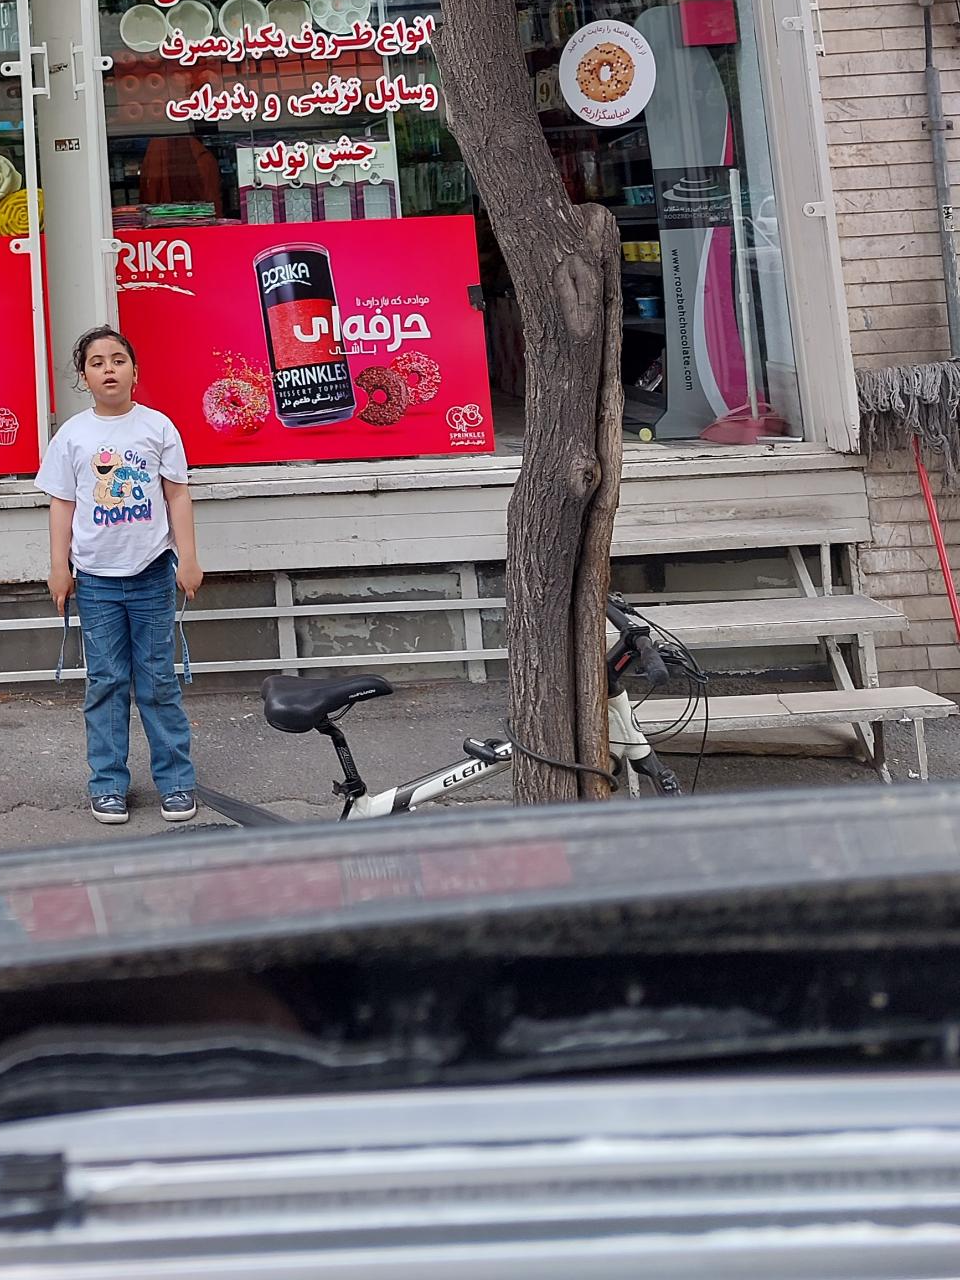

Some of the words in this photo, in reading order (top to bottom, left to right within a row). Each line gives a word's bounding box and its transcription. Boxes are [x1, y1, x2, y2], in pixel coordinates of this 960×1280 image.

[159, 28, 230, 65] مصرف
[289, 21, 377, 60] ظروف
[377, 15, 436, 55] انواع
[167, 81, 259, 123] پذیرایی
[262, 95, 281, 121] و
[365, 76, 438, 113] وسایل
[579, 105, 632, 122] سپاسگزاریم
[256, 140, 309, 179] تولد
[313, 136, 377, 174] جشن
[261, 262, 310, 288] DORIKA
[390, 295, 402, 306] که
[403, 294, 430, 306] موادی
[671, 248, 694, 392] www.roozbehchocolate.com
[276, 363, 349, 390] SPRINKLES
[124, 450, 147, 470] Give
